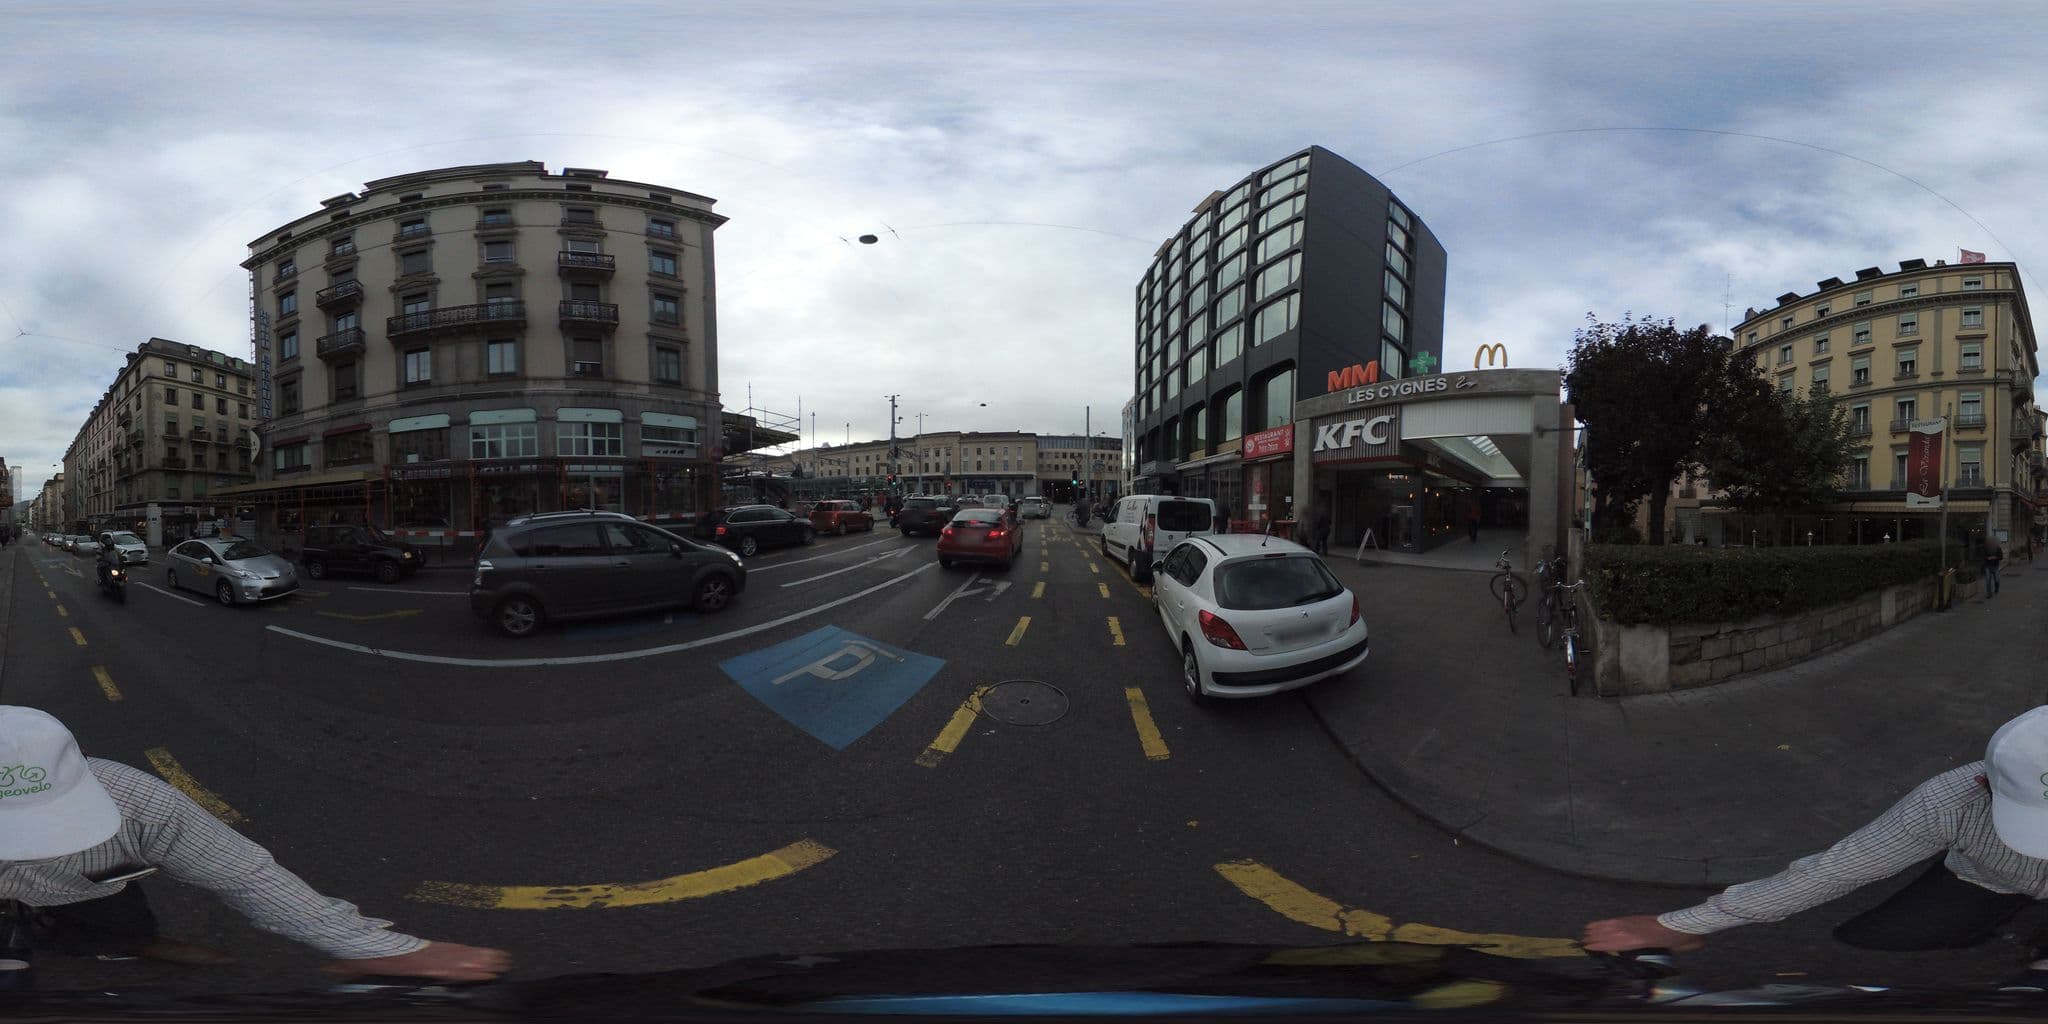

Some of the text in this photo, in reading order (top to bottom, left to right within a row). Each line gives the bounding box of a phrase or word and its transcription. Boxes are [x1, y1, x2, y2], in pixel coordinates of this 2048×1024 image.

[1327, 360, 1378, 393] MM
[1348, 377, 1448, 404] LES CYGNES
[1313, 415, 1393, 452] KFC
